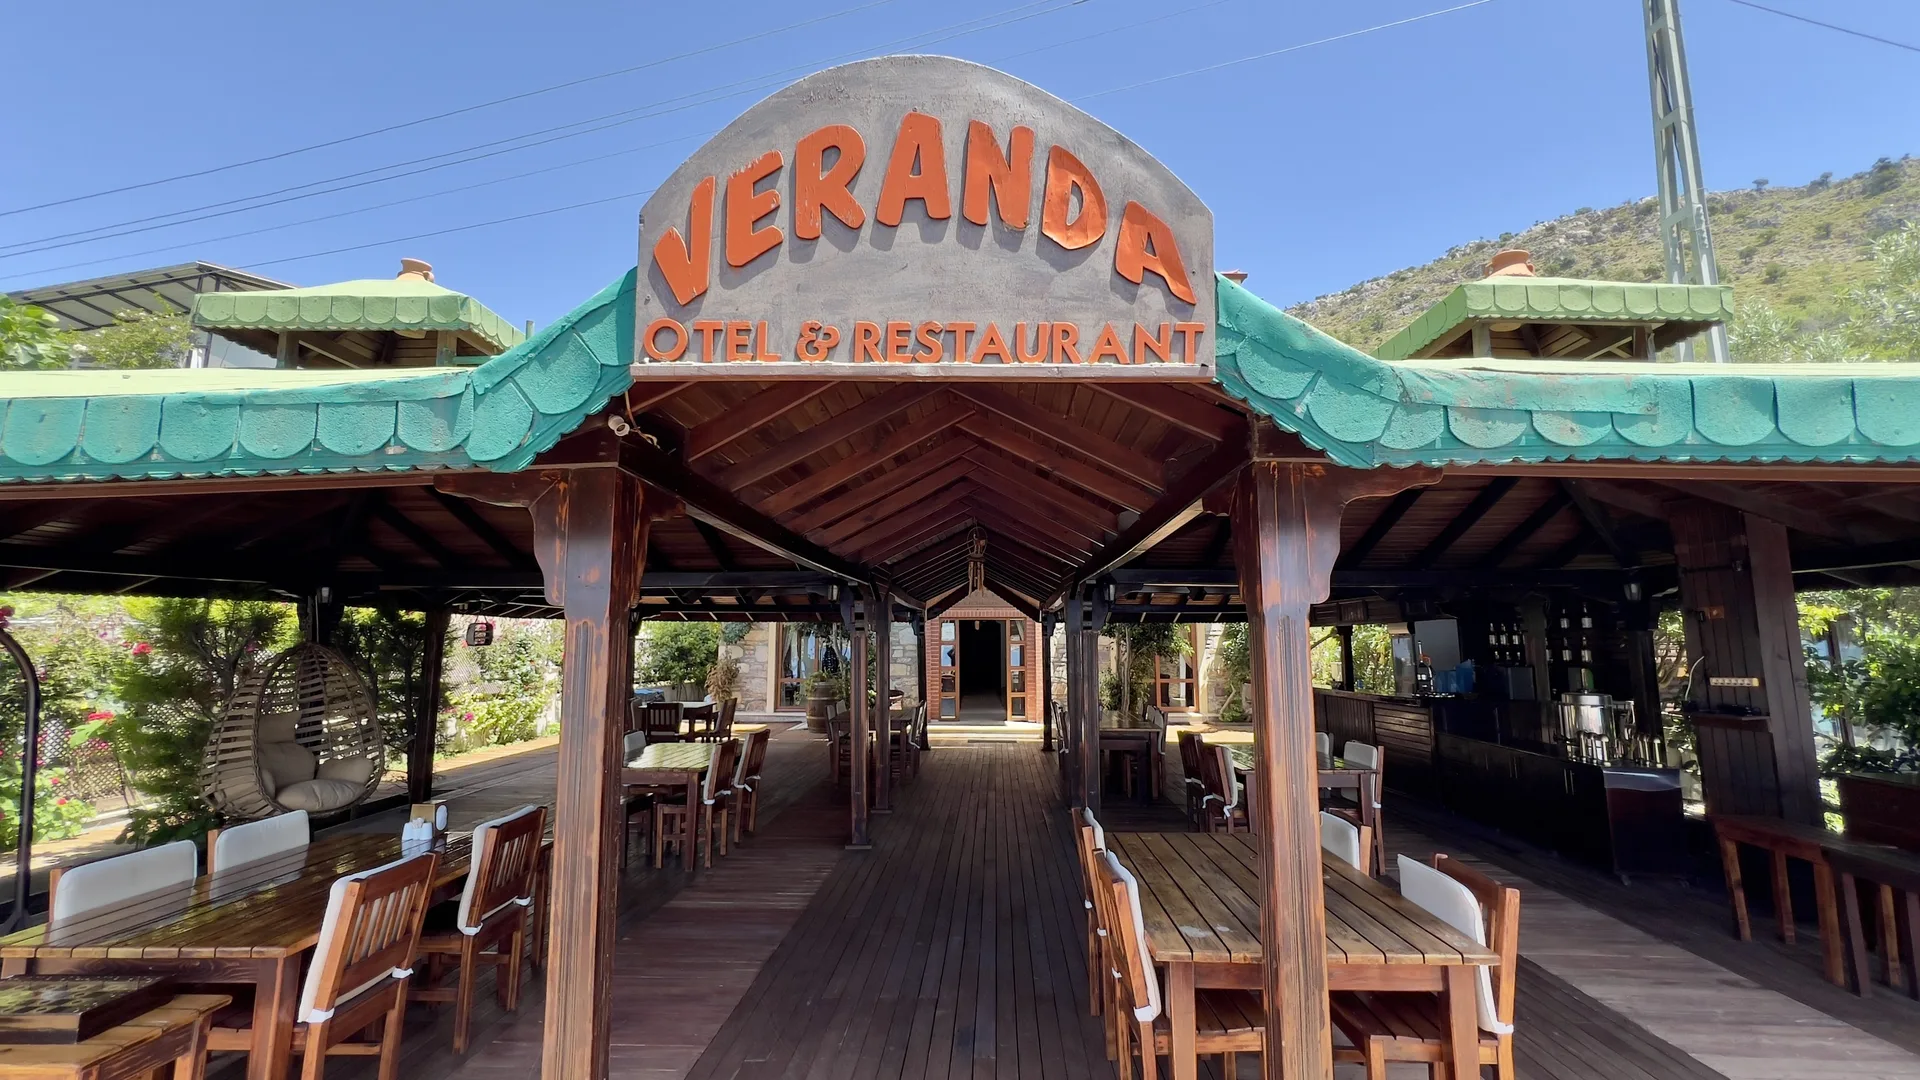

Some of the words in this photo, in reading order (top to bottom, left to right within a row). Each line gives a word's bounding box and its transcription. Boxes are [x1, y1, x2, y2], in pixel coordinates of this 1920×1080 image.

[653, 111, 1197, 306] VERANDA
[643, 317, 781, 363] OTEL
[796, 320, 841, 363] &
[854, 321, 1206, 364] RESTAURANT
